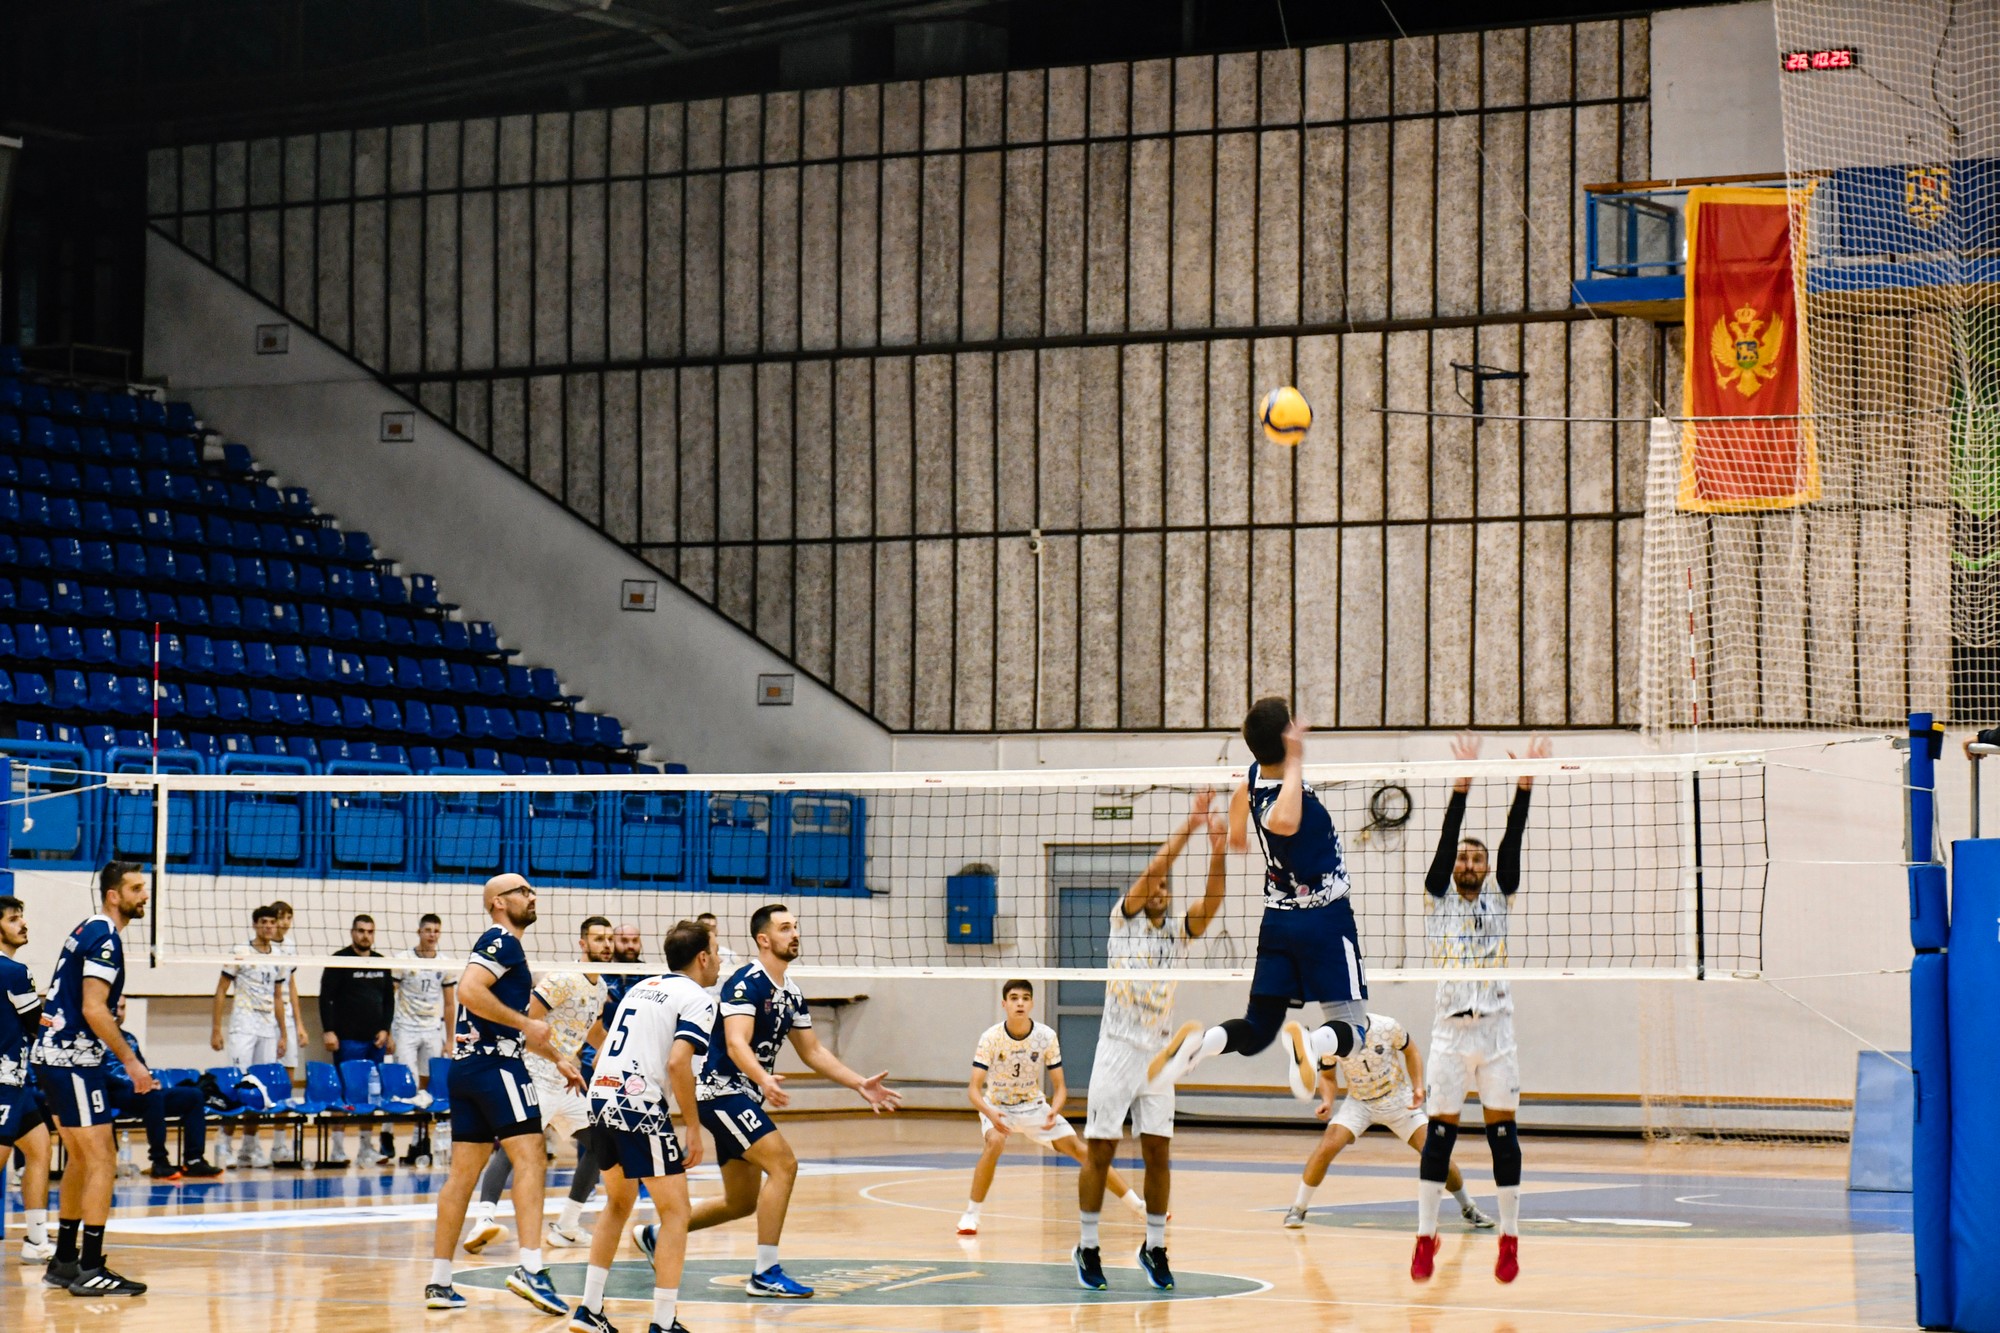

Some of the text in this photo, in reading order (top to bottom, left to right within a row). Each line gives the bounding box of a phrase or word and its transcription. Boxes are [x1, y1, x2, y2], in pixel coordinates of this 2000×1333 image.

[421, 979, 431, 992] 17
[608, 1008, 637, 1057] 5
[1012, 1063, 1021, 1078] 3
[1362, 1059, 1371, 1073] 1
[91, 1089, 105, 1114] 9
[521, 1082, 538, 1107] 10
[0, 1104, 11, 1126] 7
[737, 1108, 763, 1133] 12
[666, 1137, 679, 1162] 5
